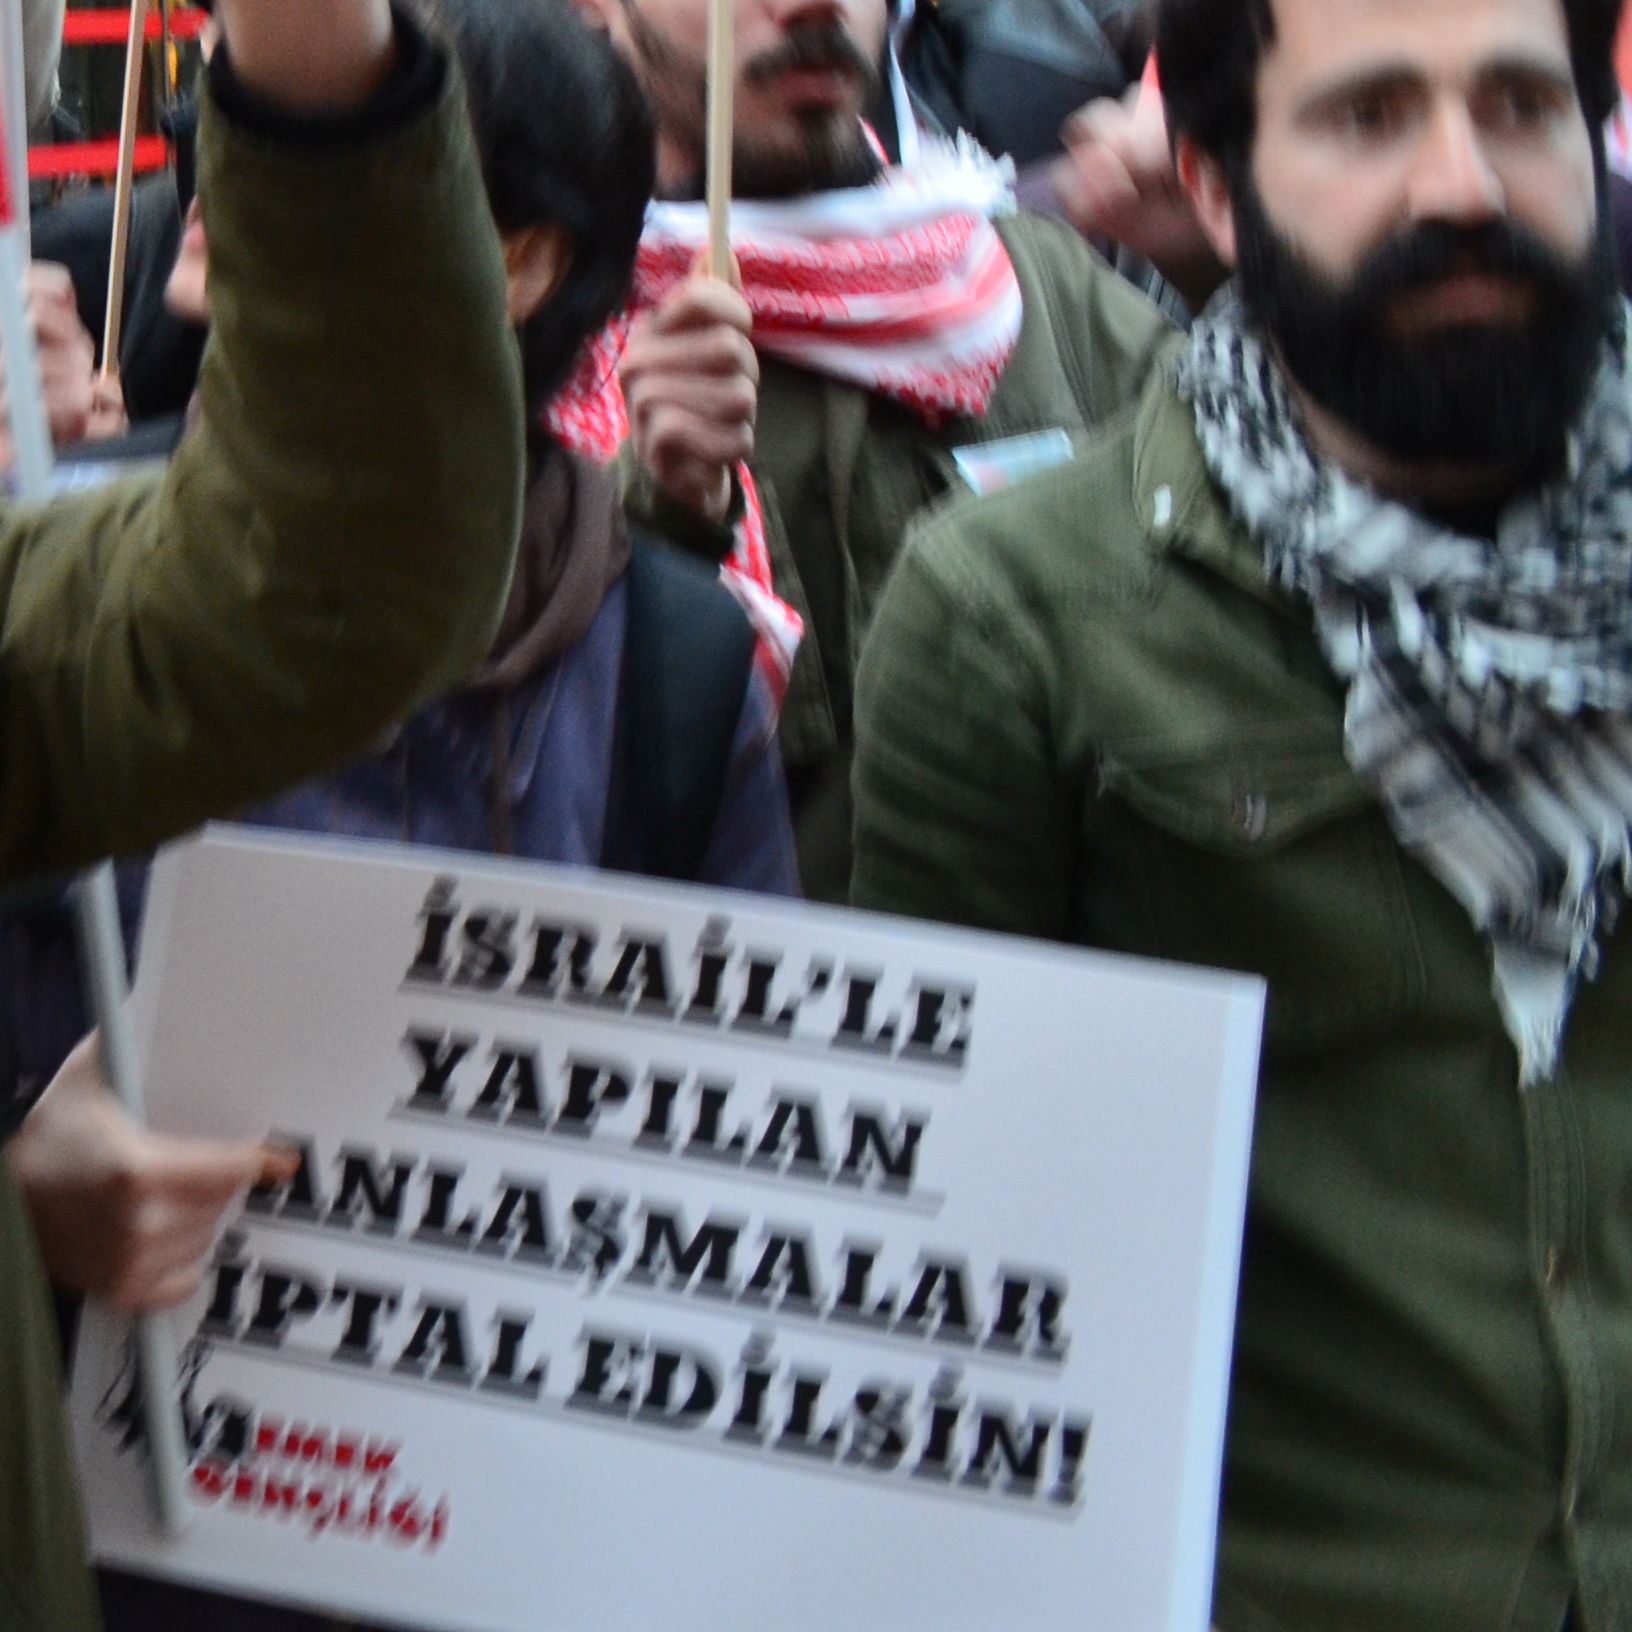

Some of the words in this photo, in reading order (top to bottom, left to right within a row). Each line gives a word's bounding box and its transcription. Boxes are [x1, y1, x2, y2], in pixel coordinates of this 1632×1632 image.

[402, 873, 976, 1072] İSRAİL'LE
[400, 1022, 933, 1196] YAPILAN
[244, 1128, 1071, 1365] ANLAŞMALAR
[200, 1226, 544, 1390] İPTAL
[560, 1328, 1092, 1506] EDİLSİN!
